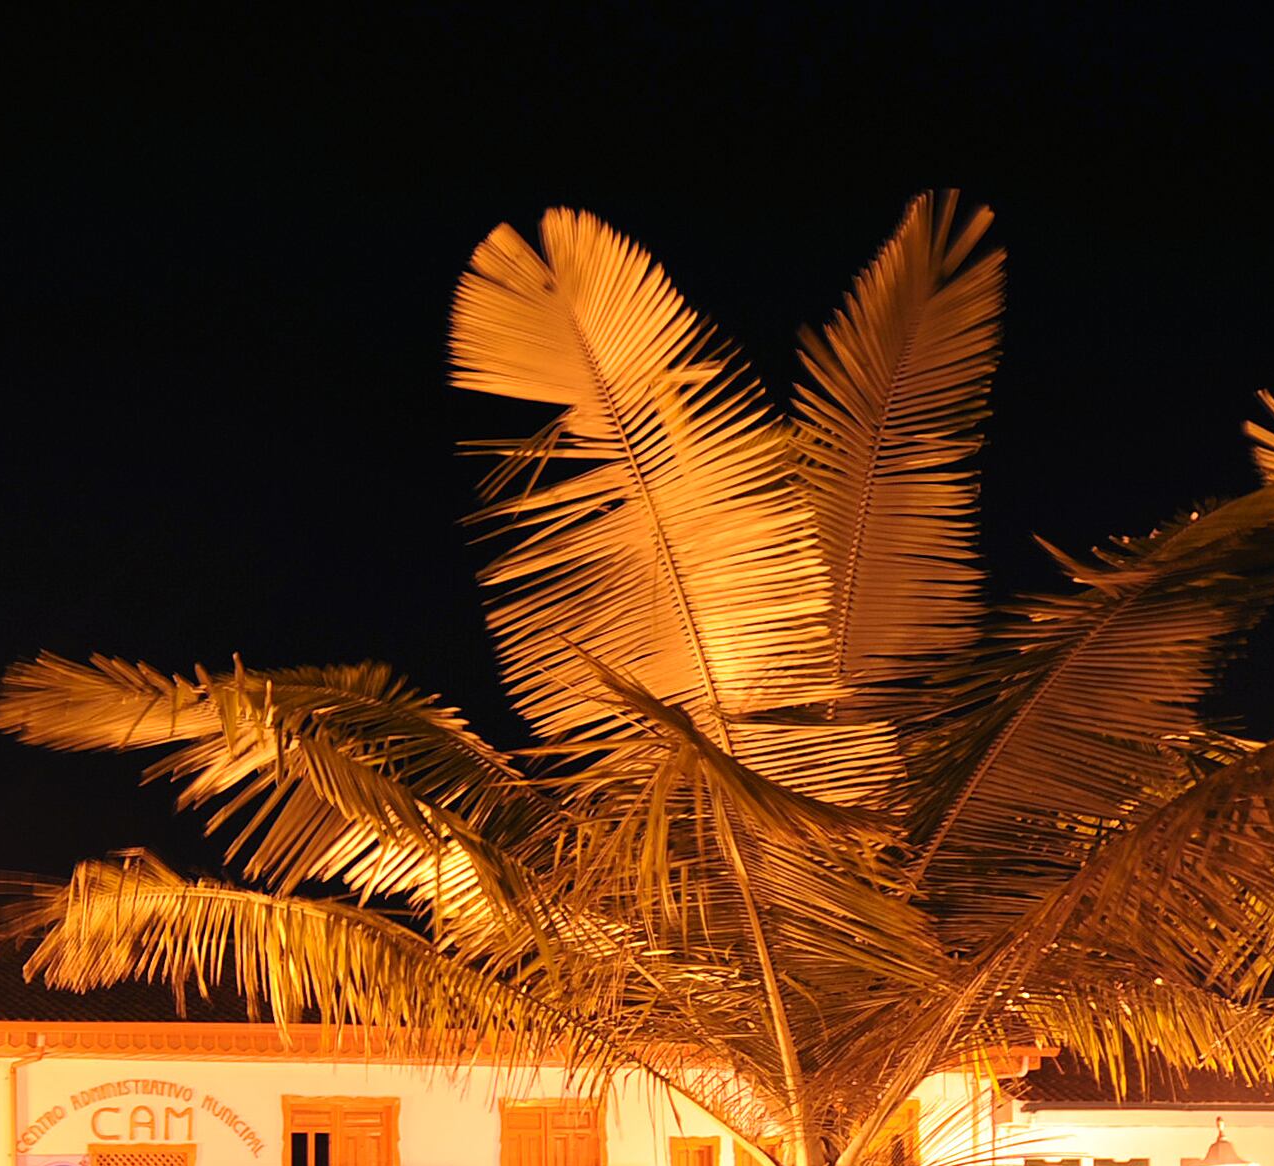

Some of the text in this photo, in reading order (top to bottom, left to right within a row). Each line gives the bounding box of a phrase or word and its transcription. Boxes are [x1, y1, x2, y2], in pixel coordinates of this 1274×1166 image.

[16, 1079, 266, 1158] CENTRO ADMINISTRATIVO MUNICIPAL
[91, 1105, 193, 1140] CAM
